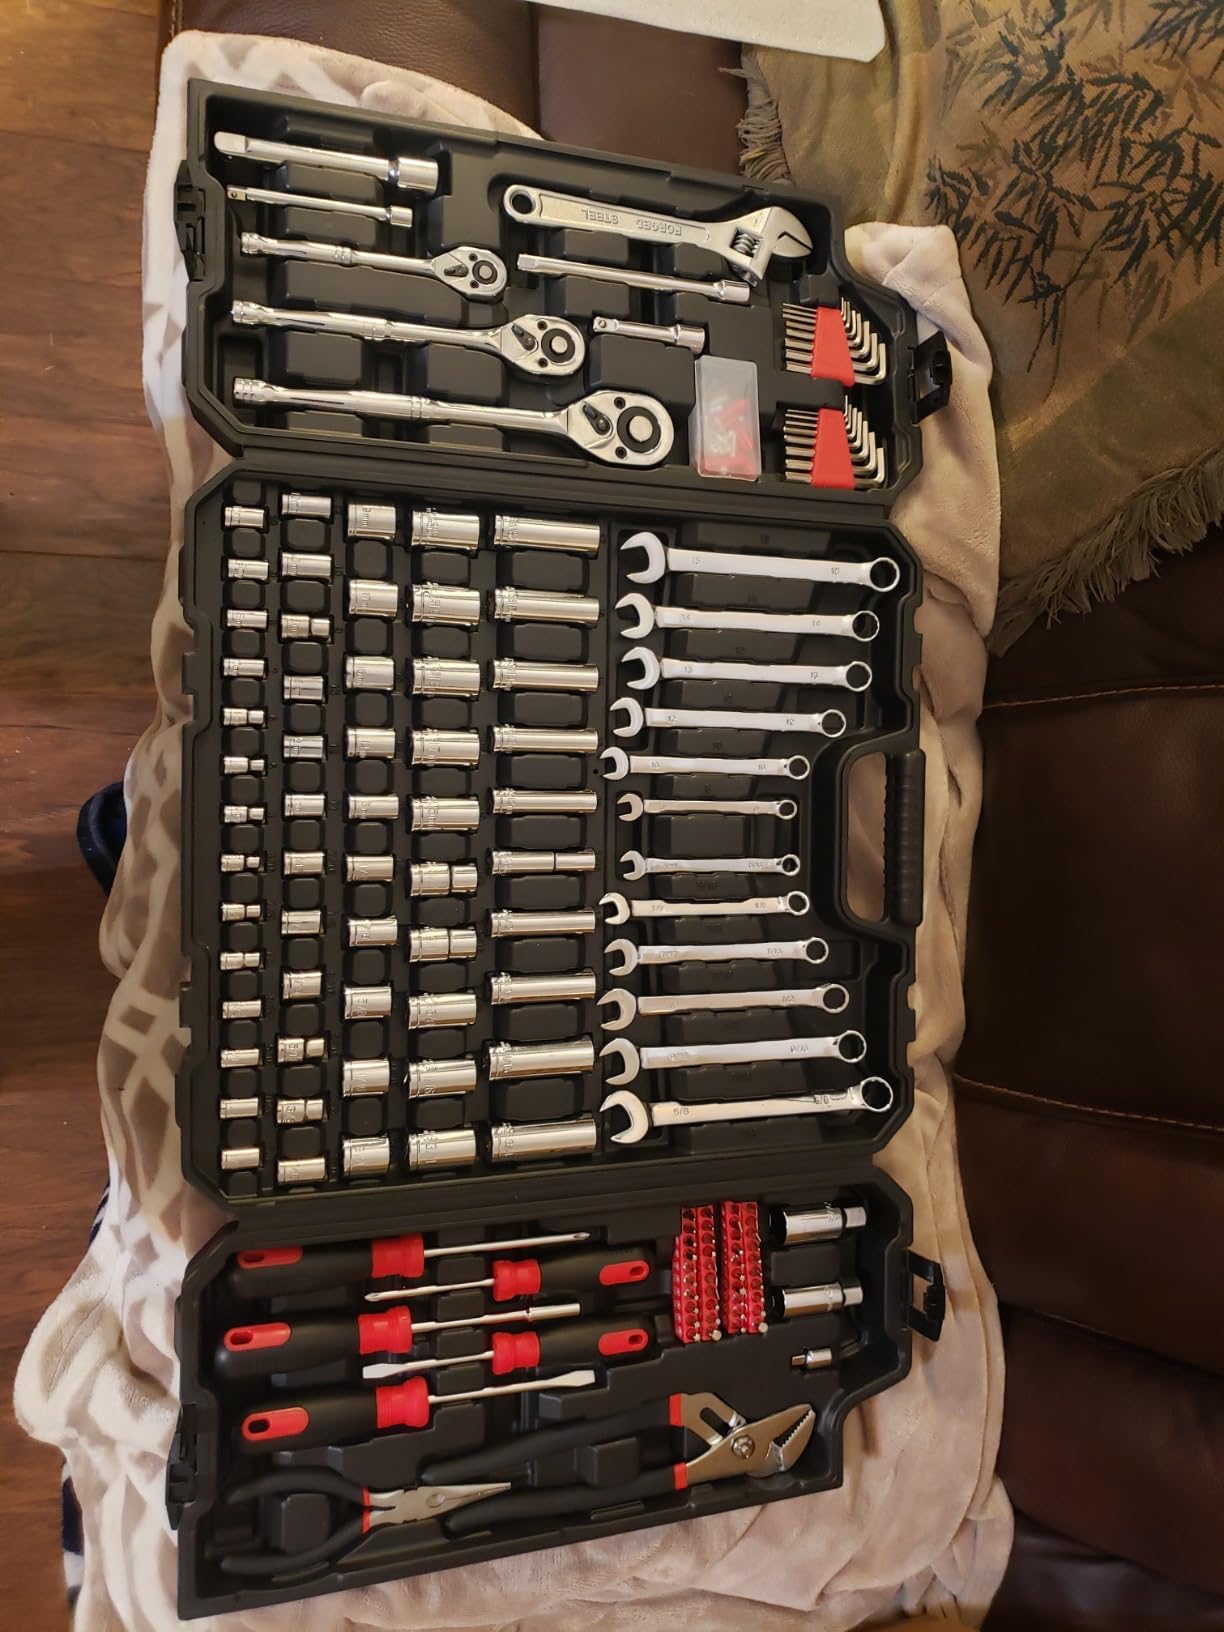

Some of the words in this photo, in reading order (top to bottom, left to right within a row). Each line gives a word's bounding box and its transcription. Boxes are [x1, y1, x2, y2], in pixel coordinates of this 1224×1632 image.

[580, 208, 620, 225] STEEL
[635, 218, 683, 236] FORGED
[673, 1107, 690, 1116] 5/8
